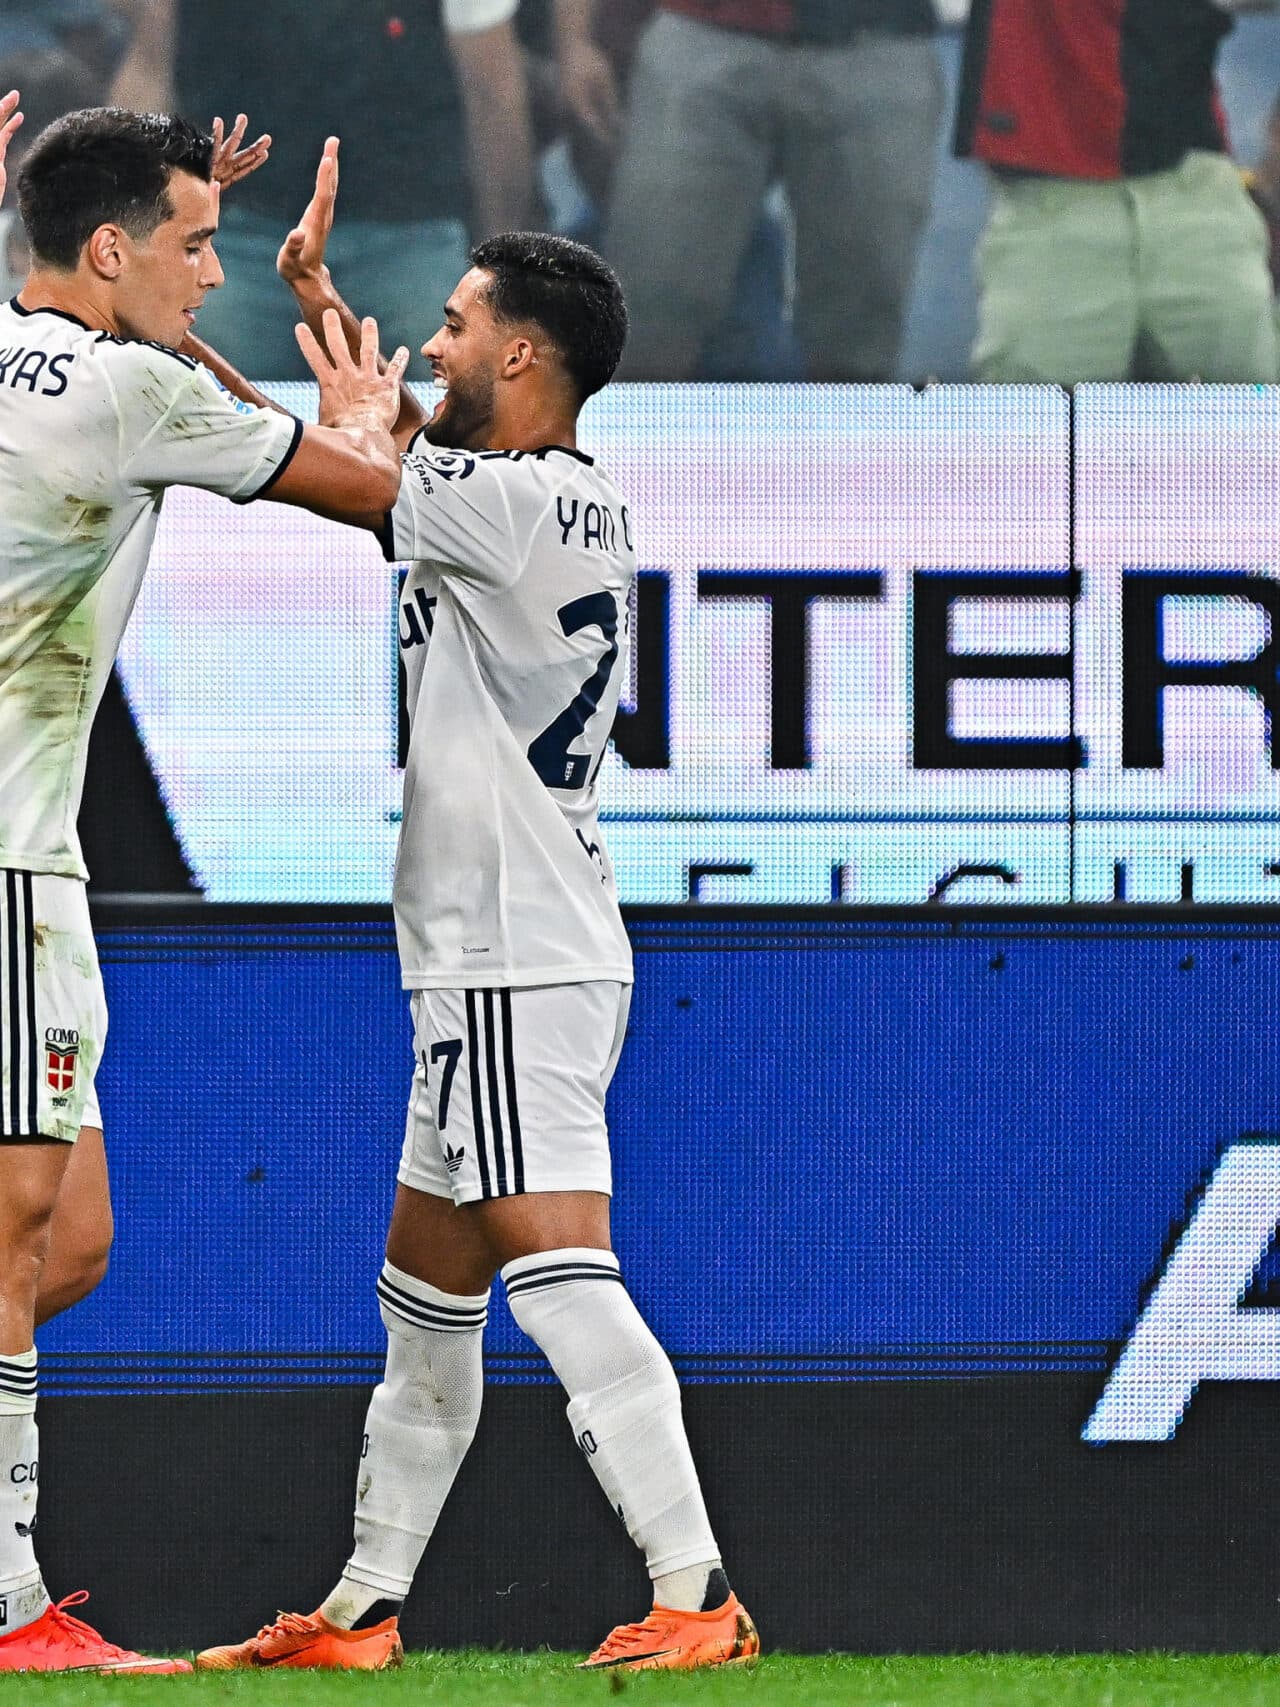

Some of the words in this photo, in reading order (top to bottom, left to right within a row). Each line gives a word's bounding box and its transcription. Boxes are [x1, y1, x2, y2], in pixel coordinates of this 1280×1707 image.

[526, 578, 632, 790] 2
[45, 1027, 79, 1044] COMO
[421, 1038, 463, 1131] 7
